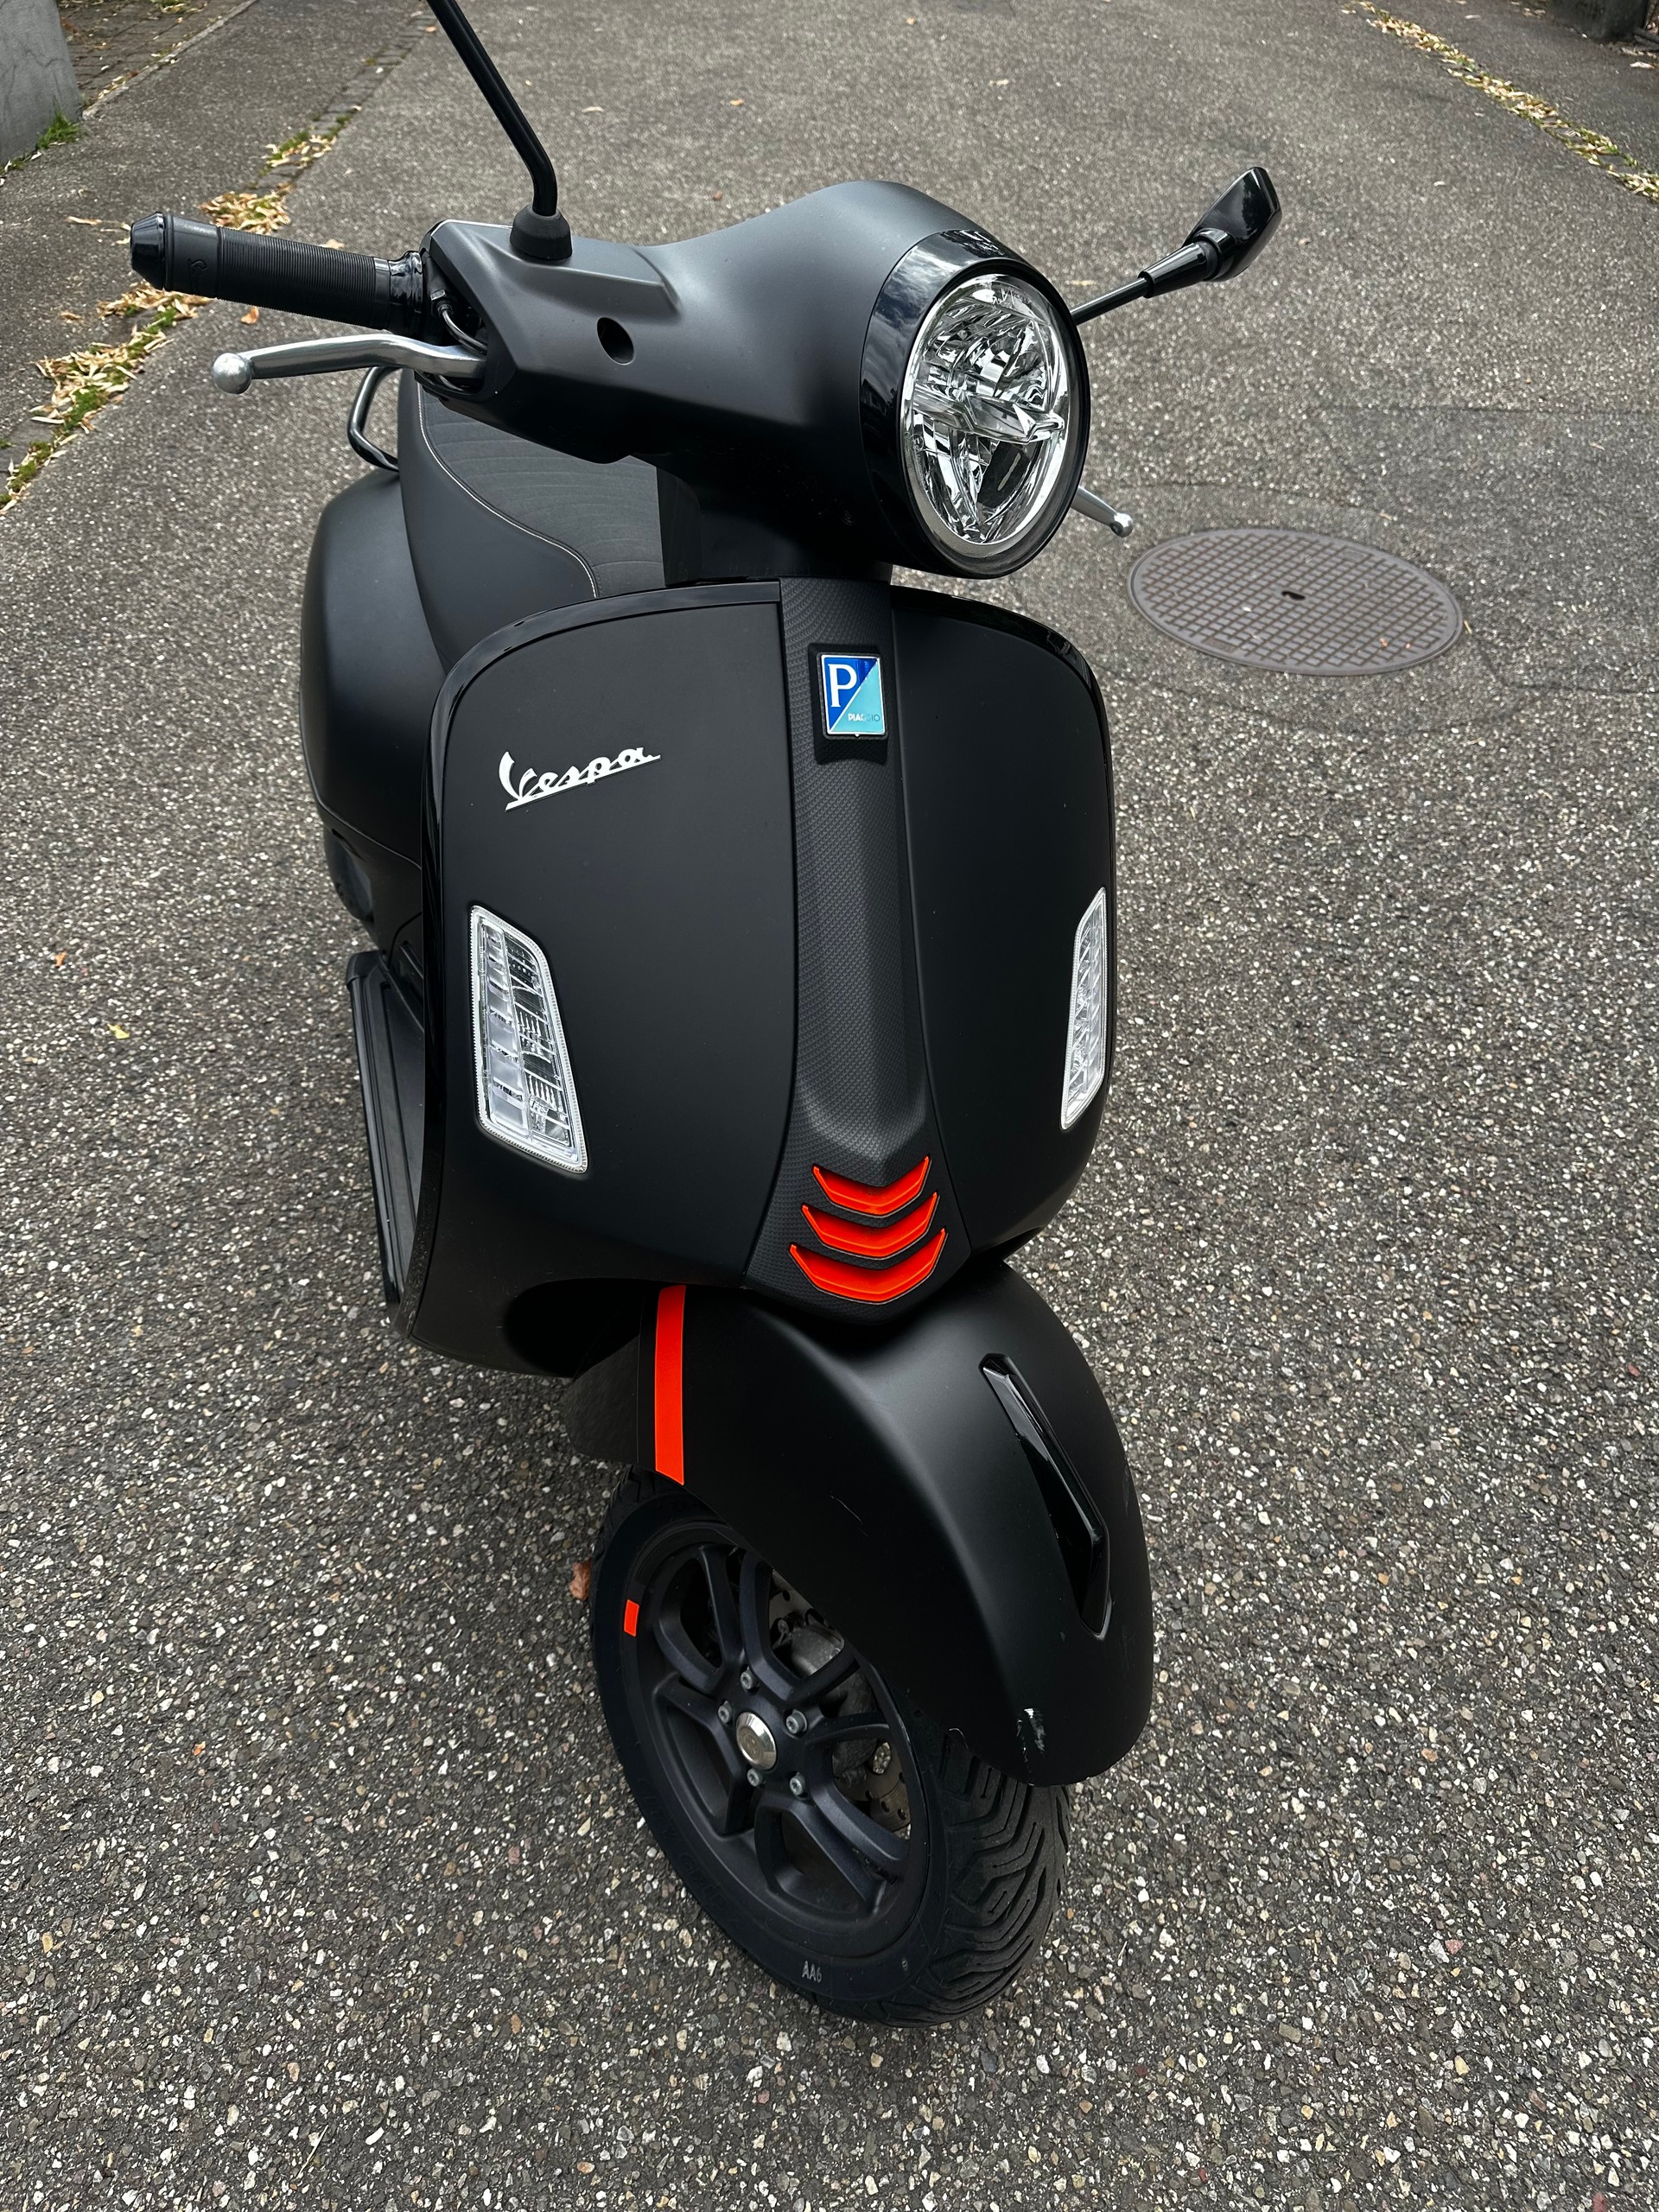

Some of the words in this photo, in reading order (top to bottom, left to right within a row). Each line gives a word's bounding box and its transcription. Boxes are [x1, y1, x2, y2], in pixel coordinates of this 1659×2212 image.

[828, 664, 858, 708] P
[499, 747, 662, 811] Vespa
[802, 1960, 823, 1983] AA6
